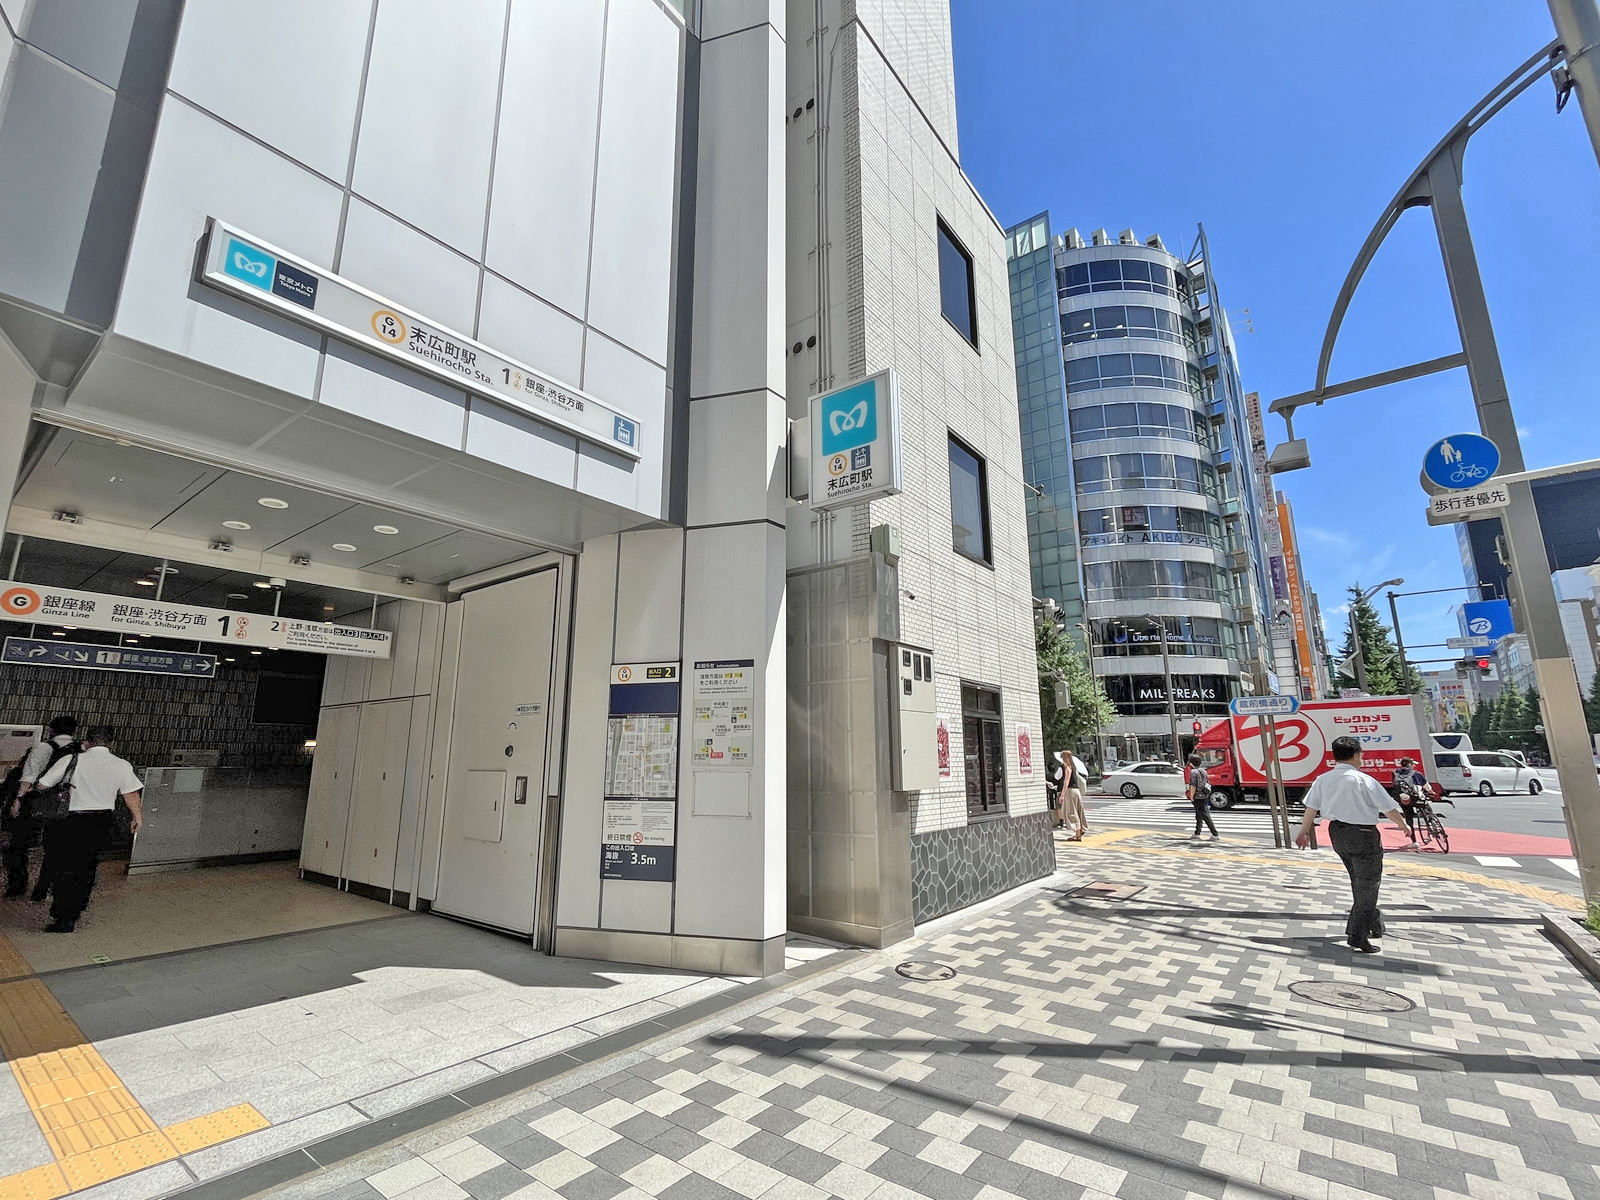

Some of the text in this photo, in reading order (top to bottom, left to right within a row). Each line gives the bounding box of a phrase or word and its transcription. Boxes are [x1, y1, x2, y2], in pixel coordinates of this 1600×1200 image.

[279, 273, 314, 294] 東京メトロ
[385, 316, 394, 326] G
[381, 324, 397, 338] 14
[410, 326, 477, 367] 末広町駅
[409, 341, 494, 386] Suehirocho Sta.
[502, 367, 511, 385] 1
[525, 377, 585, 413] 銀座・渋谷方面
[833, 463, 843, 472] 14
[828, 468, 873, 490] 末広町駅
[827, 482, 873, 499] Suehirocho Sta.
[1434, 490, 1506, 513] 歩行者優先
[1142, 532, 1180, 544] AKIBA
[14, 596, 28, 607] G
[43, 595, 96, 612] 銀座線
[41, 608, 90, 619] Ginza Line
[112, 604, 208, 626] 銀座・渋谷方面
[126, 617, 152, 627] Ginza,
[154, 620, 187, 631] Shibuya
[217, 615, 231, 637] 1
[270, 621, 280, 632] 2
[664, 667, 671, 677] 2
[1140, 688, 1216, 699] MIL-FREAKS
[1333, 714, 1391, 724] ビックカメラ
[1349, 725, 1378, 733] コジマ
[607, 834, 632, 842] 終日禁煙
[605, 851, 619, 860] 海抜
[630, 852, 657, 866] 3.5m
